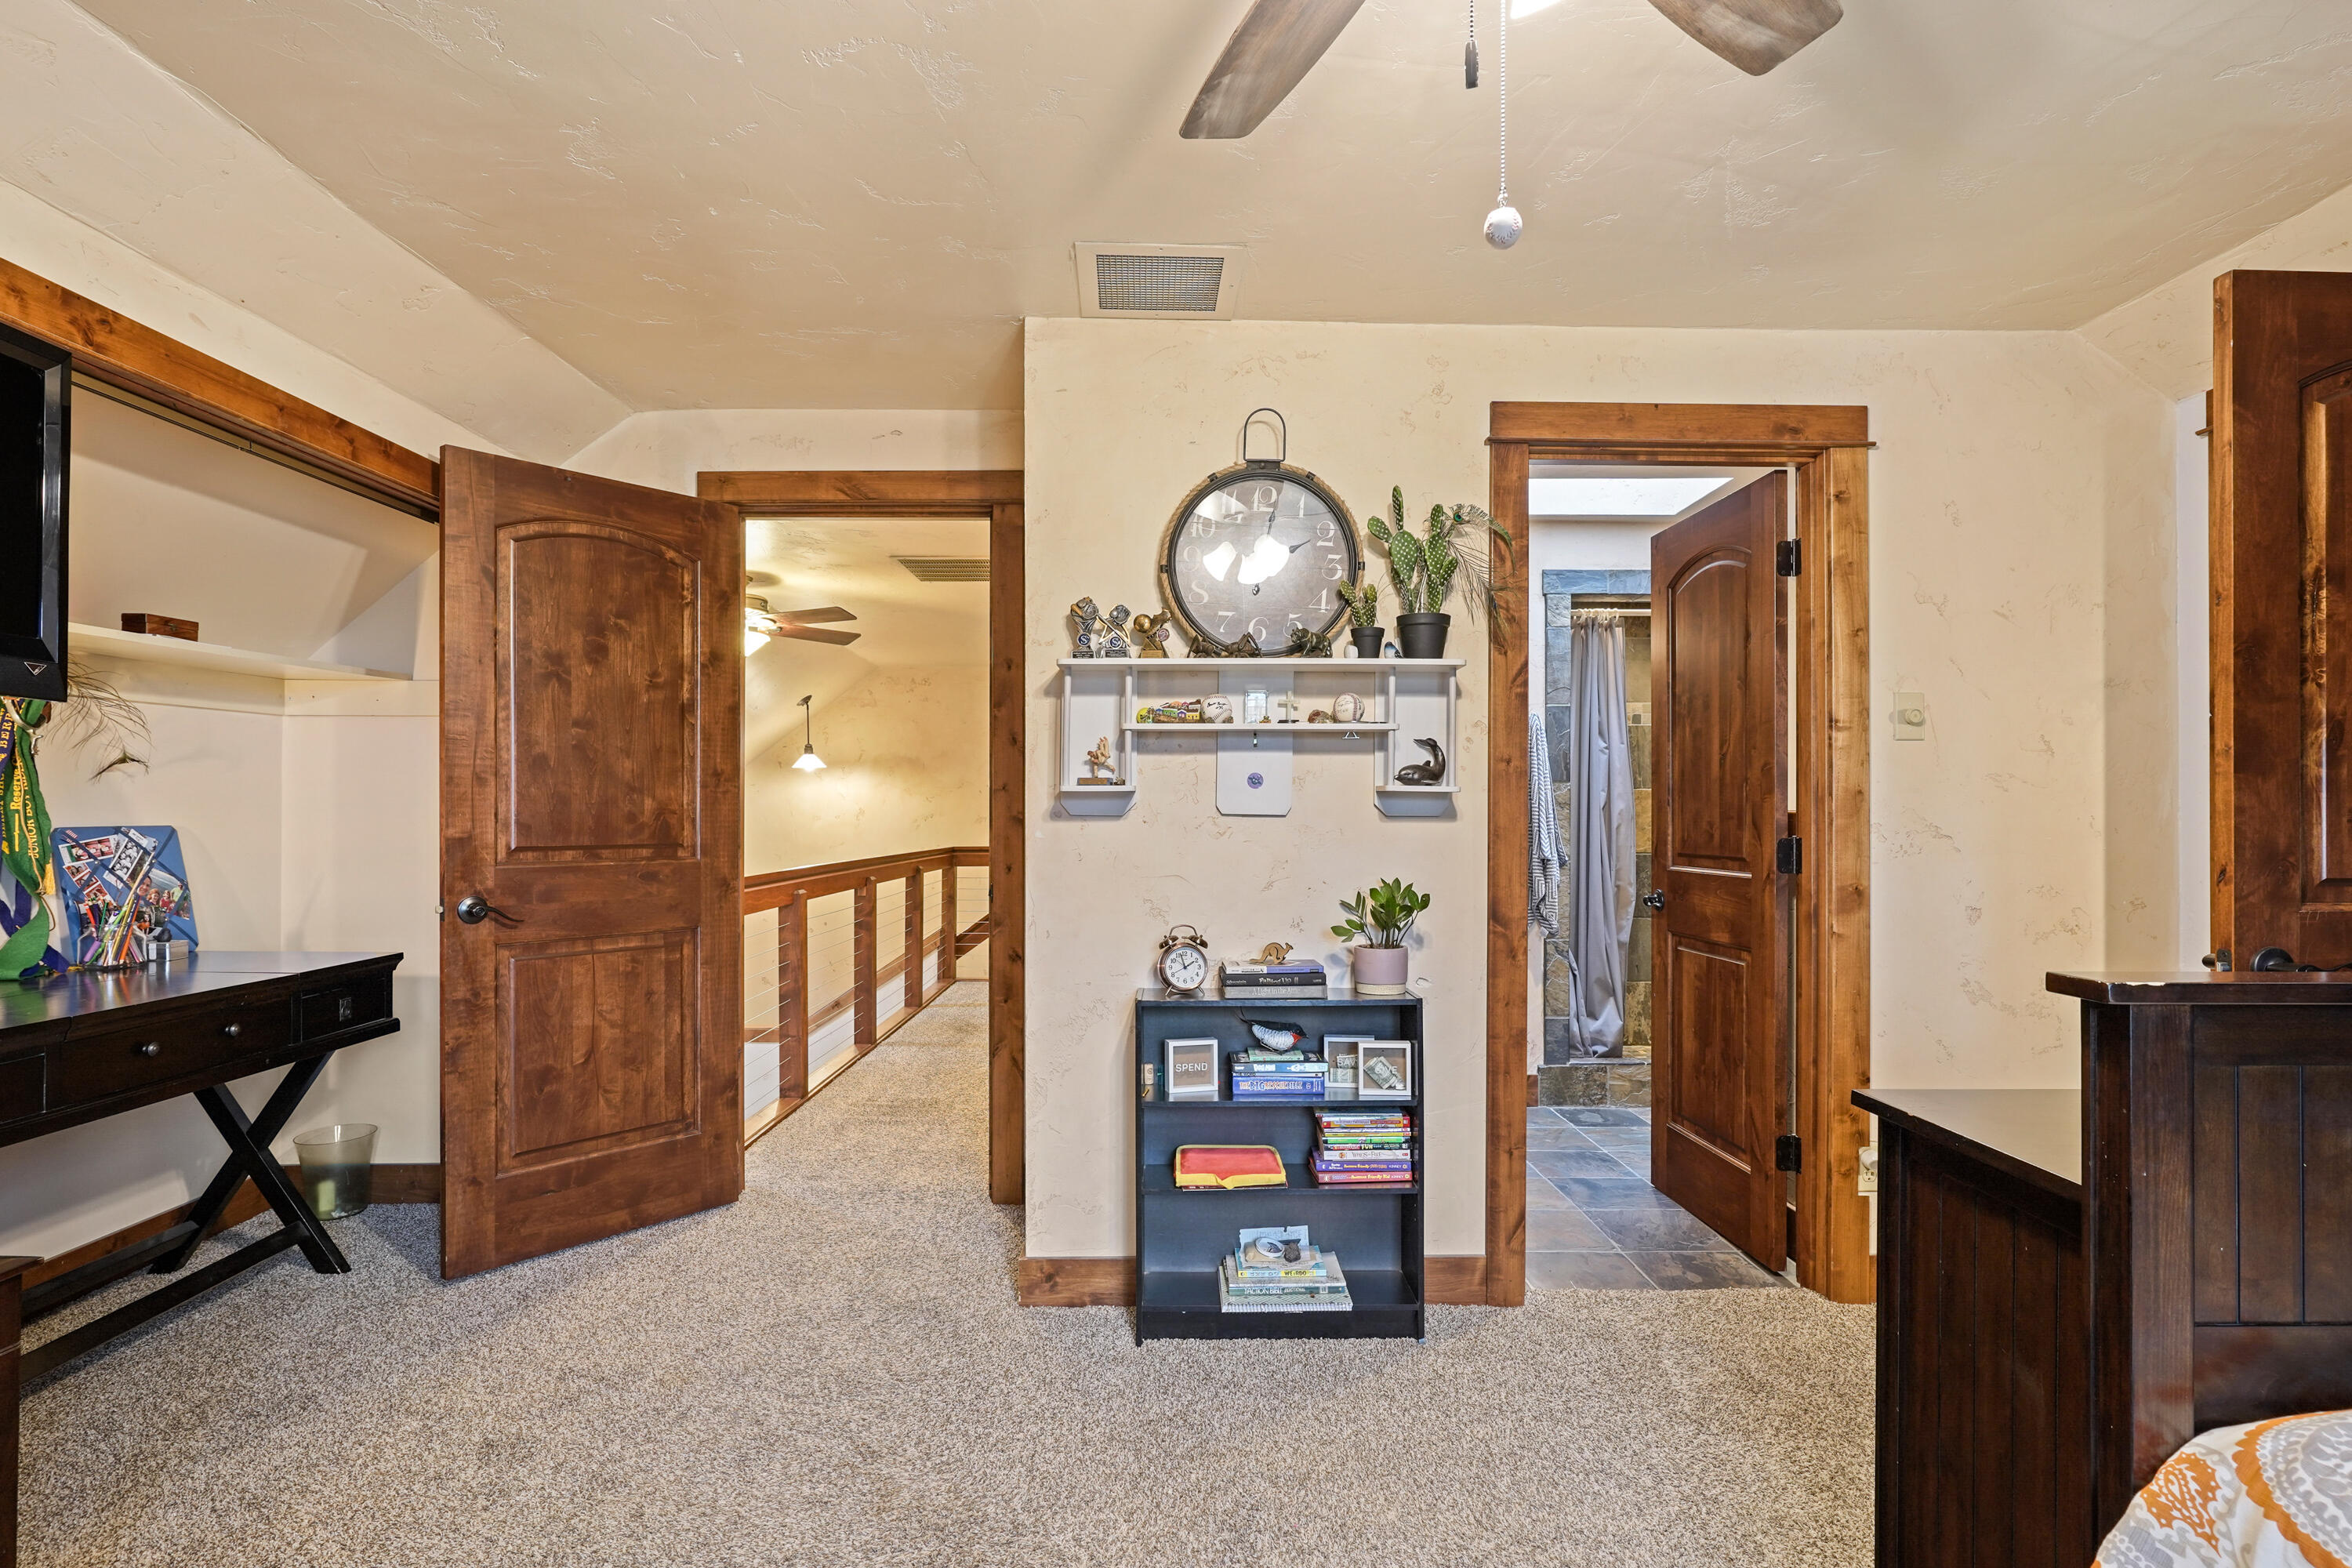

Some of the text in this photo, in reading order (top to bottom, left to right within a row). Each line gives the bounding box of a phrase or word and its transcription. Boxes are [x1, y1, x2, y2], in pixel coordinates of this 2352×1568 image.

[1221, 489, 1238, 514] 11
[1251, 486, 1277, 512] 12
[1297, 492, 1305, 517] 1
[1190, 514, 1215, 538] 10
[1316, 521, 1335, 546] 2
[1181, 546, 1202, 572] 9
[1322, 554, 1342, 580] 3
[1189, 580, 1208, 604] 8
[1308, 588, 1330, 613] 4
[1216, 612, 1236, 633] 7
[1247, 617, 1269, 642] 6
[1283, 613, 1303, 639] 5
[10, 768, 21, 809] Reserve
[1175, 1063, 1208, 1073] SPEND
[1338, 1058, 1358, 1066] SAV
[1250, 1080, 1265, 1091] BIG
